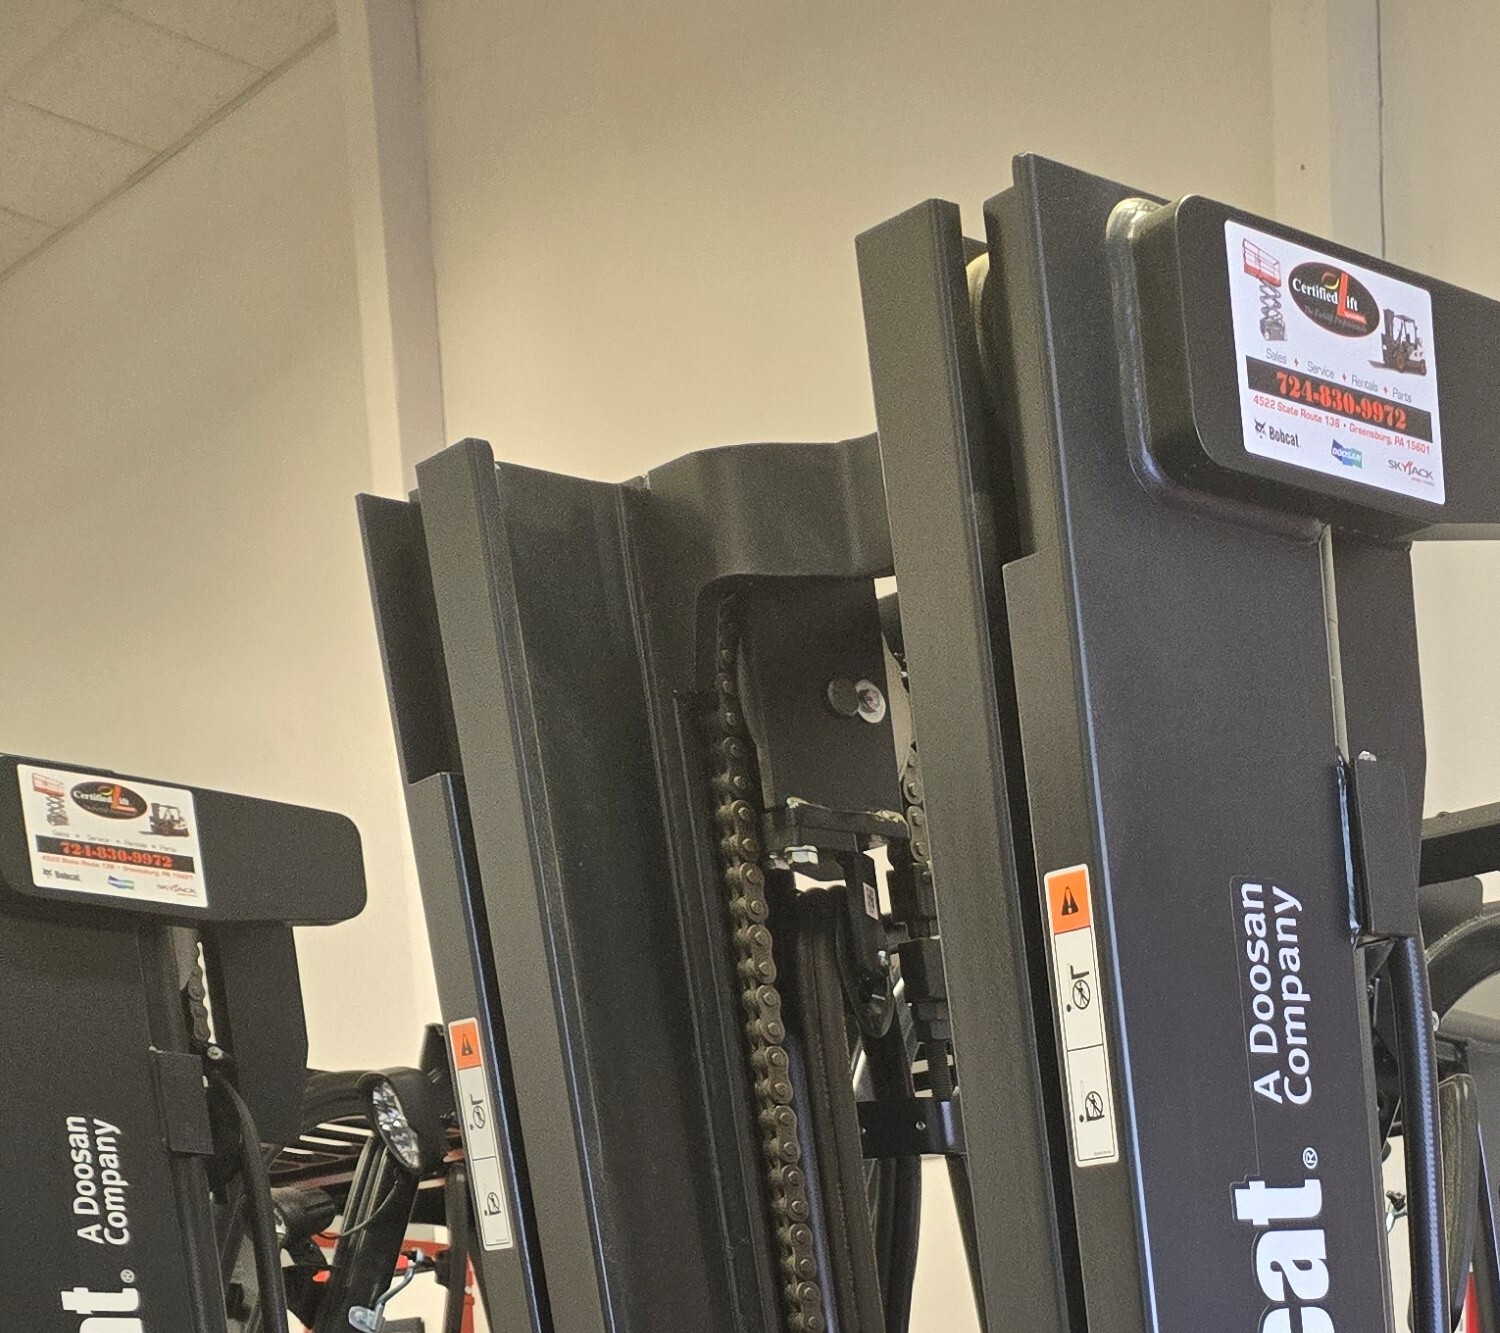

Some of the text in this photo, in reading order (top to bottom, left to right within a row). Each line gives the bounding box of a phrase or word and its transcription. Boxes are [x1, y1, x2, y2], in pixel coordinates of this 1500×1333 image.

[1292, 278, 1338, 304] Certified
[1266, 348, 1412, 403] Sales Service Rentals Parts
[1275, 371, 1407, 430] 724-830-9972
[1253, 394, 1275, 410] 4522
[1277, 399, 1299, 415] State
[1301, 408, 1323, 424] Route
[1349, 423, 1393, 446] Greensburg,
[1394, 437, 1405, 449] PA
[1406, 439, 1431, 454] 15601
[1268, 426, 1300, 448] Bobcat
[1387, 459, 1434, 480] SKYJACK
[1241, 882, 1284, 1104] A Doosan
[1272, 885, 1312, 1105] Company
[66, 1116, 106, 1245] A Doosan
[93, 1118, 131, 1246] Company
